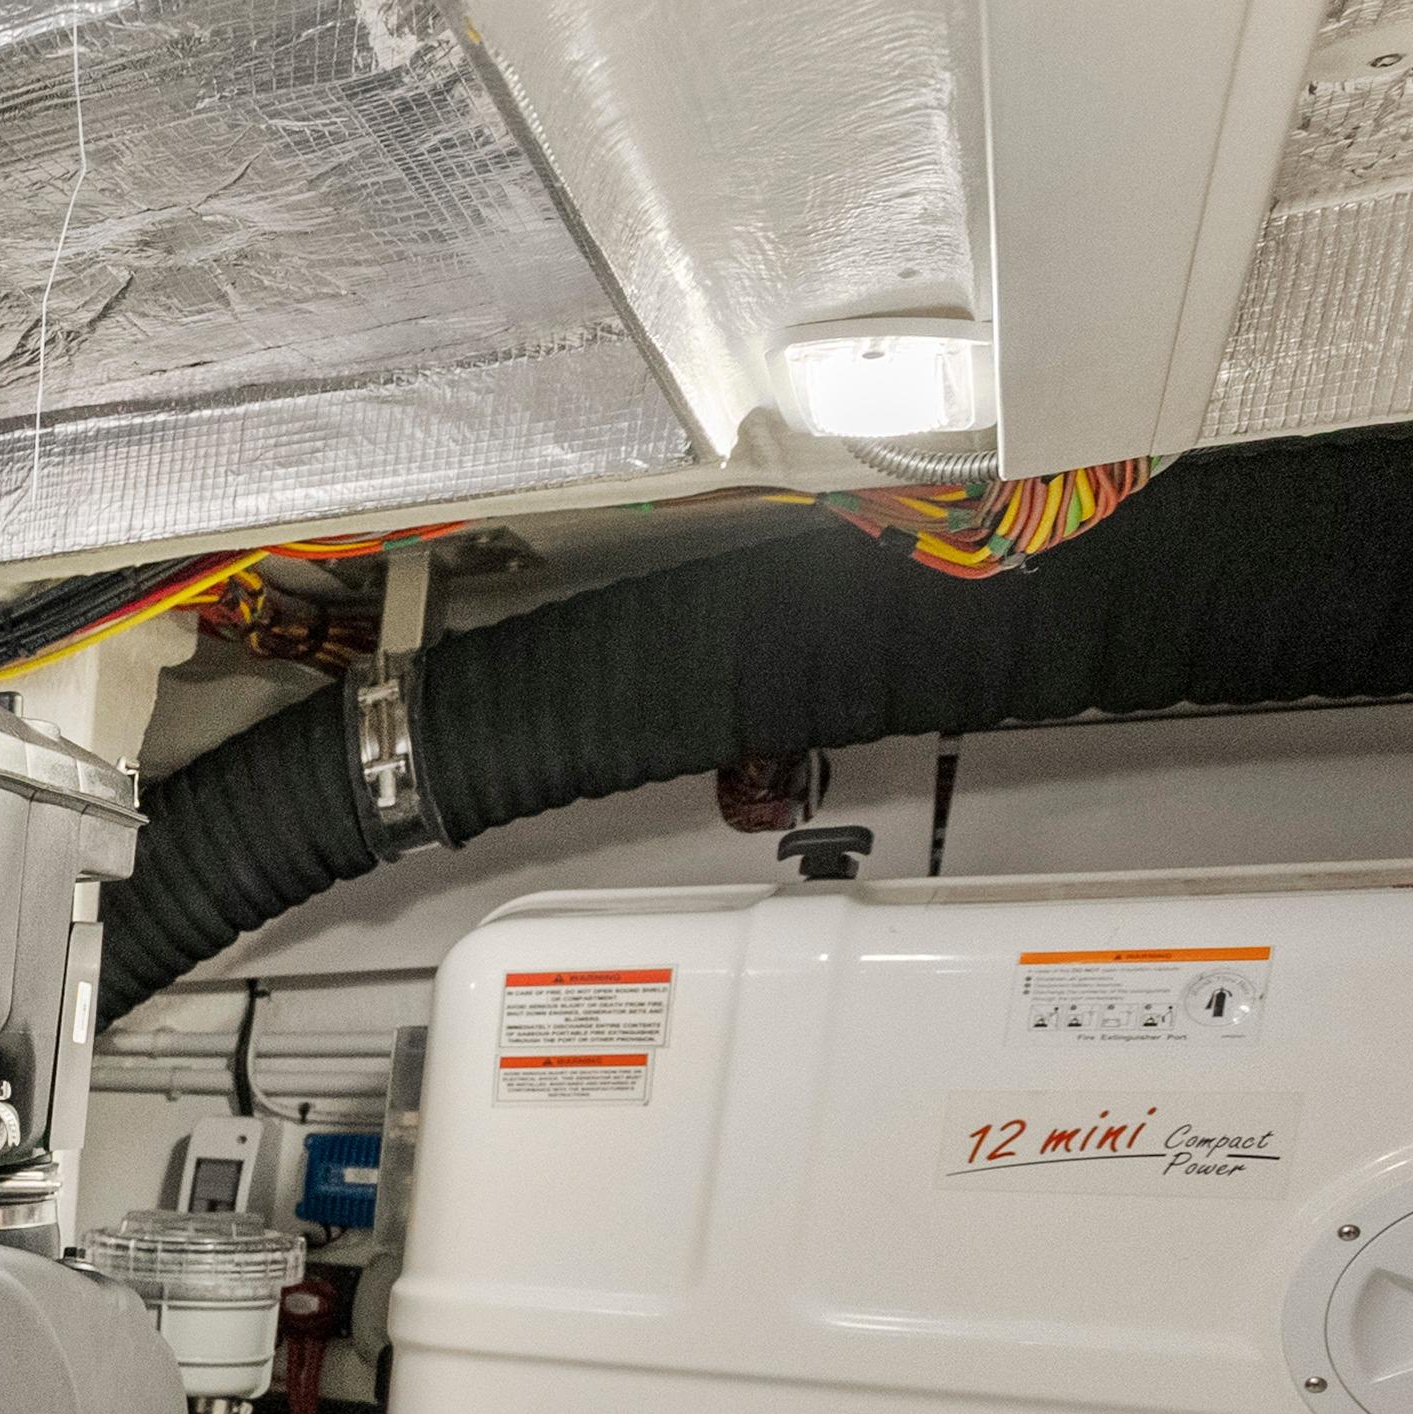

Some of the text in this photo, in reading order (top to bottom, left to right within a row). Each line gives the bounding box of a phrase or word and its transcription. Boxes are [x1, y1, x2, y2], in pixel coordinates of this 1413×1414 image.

[569, 973, 621, 982] WARNING
[1101, 1034, 1161, 1042] Extinguisher
[968, 1106, 1274, 1164] 12 mini Compact
[1163, 1151, 1247, 1176] Power
